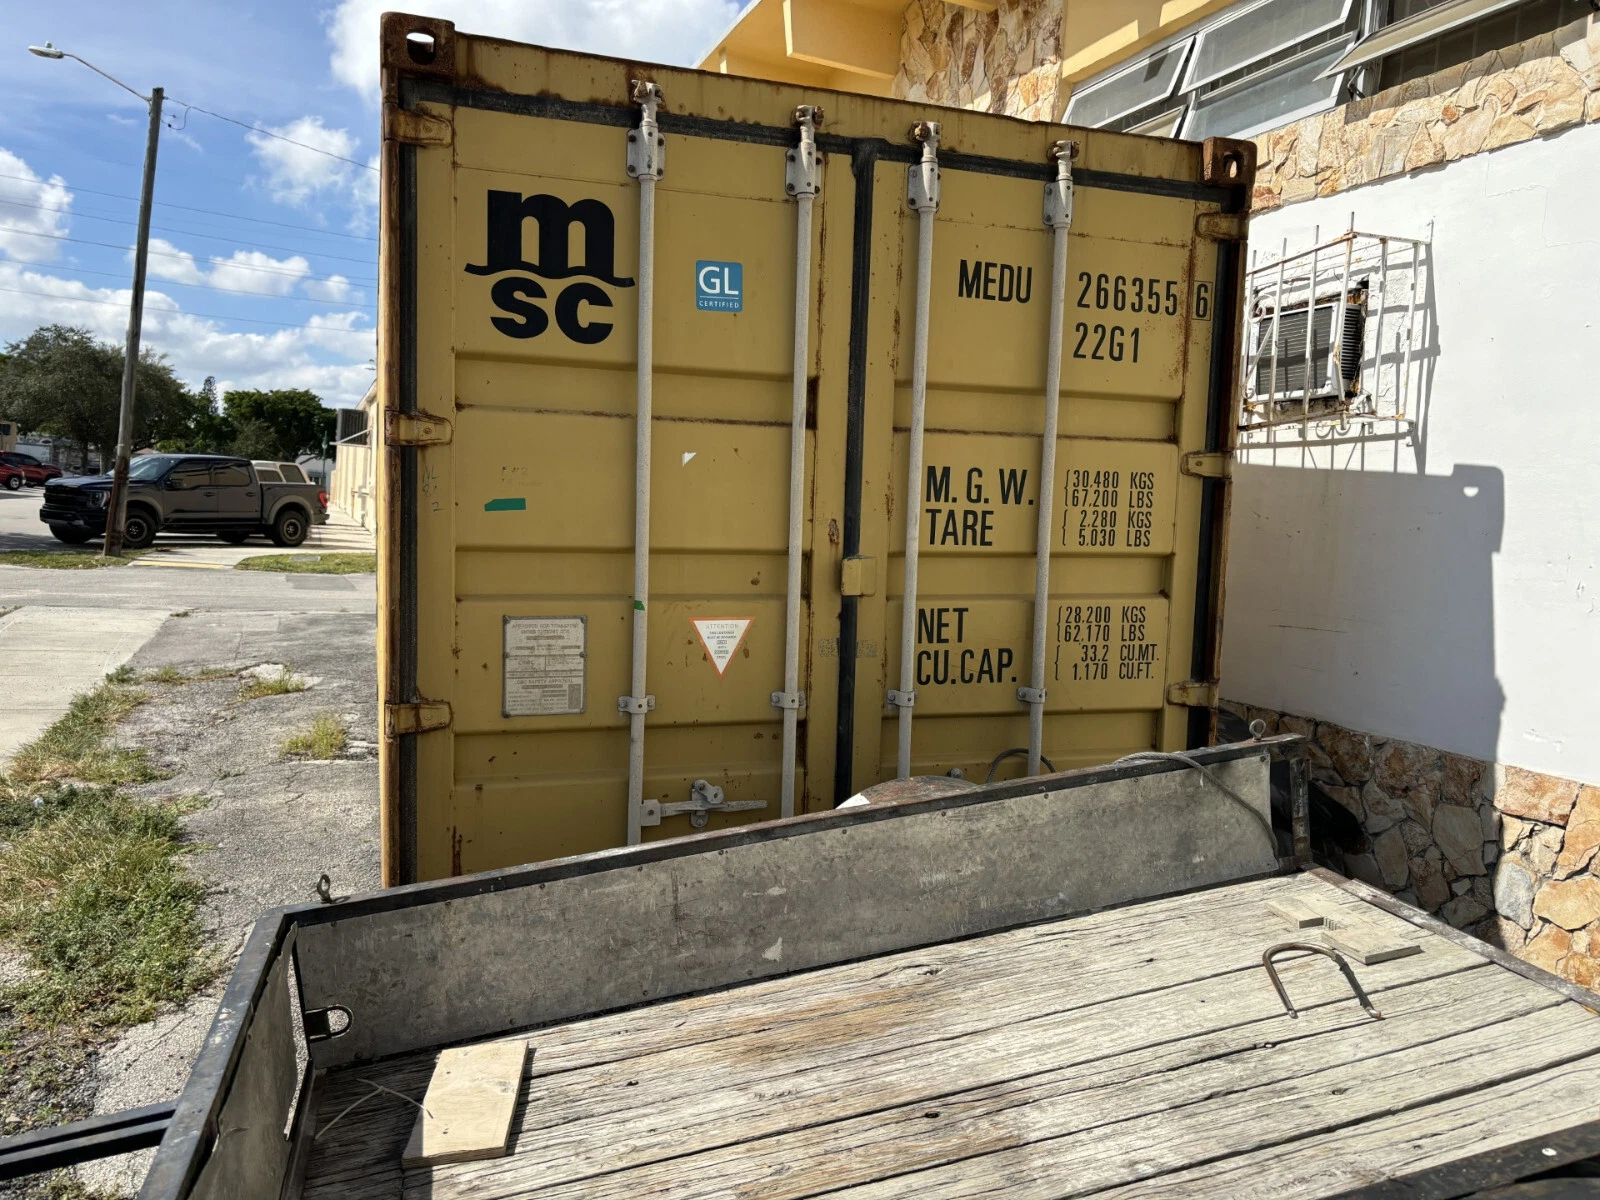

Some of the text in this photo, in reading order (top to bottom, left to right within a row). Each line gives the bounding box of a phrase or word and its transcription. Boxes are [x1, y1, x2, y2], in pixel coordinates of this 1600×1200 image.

[698, 266, 739, 295] GL
[958, 259, 1209, 318] MEDU 266355 6
[698, 300, 740, 309] CERTIFIED
[1073, 322, 1140, 363] 22G1
[1130, 471, 1154, 490] KGS
[1129, 490, 1153, 509] LBS
[925, 508, 994, 547] TARE
[1127, 508, 1152, 529] KGS
[1126, 529, 1151, 547] LBS
[1121, 605, 1146, 624] KGS
[917, 607, 969, 644] NET
[1120, 624, 1145, 642] LBS
[1081, 643, 1160, 662] 33.2 CU.MT.
[916, 647, 1017, 686] CU.CAP.
[1118, 661, 1155, 680] CU.FT.
